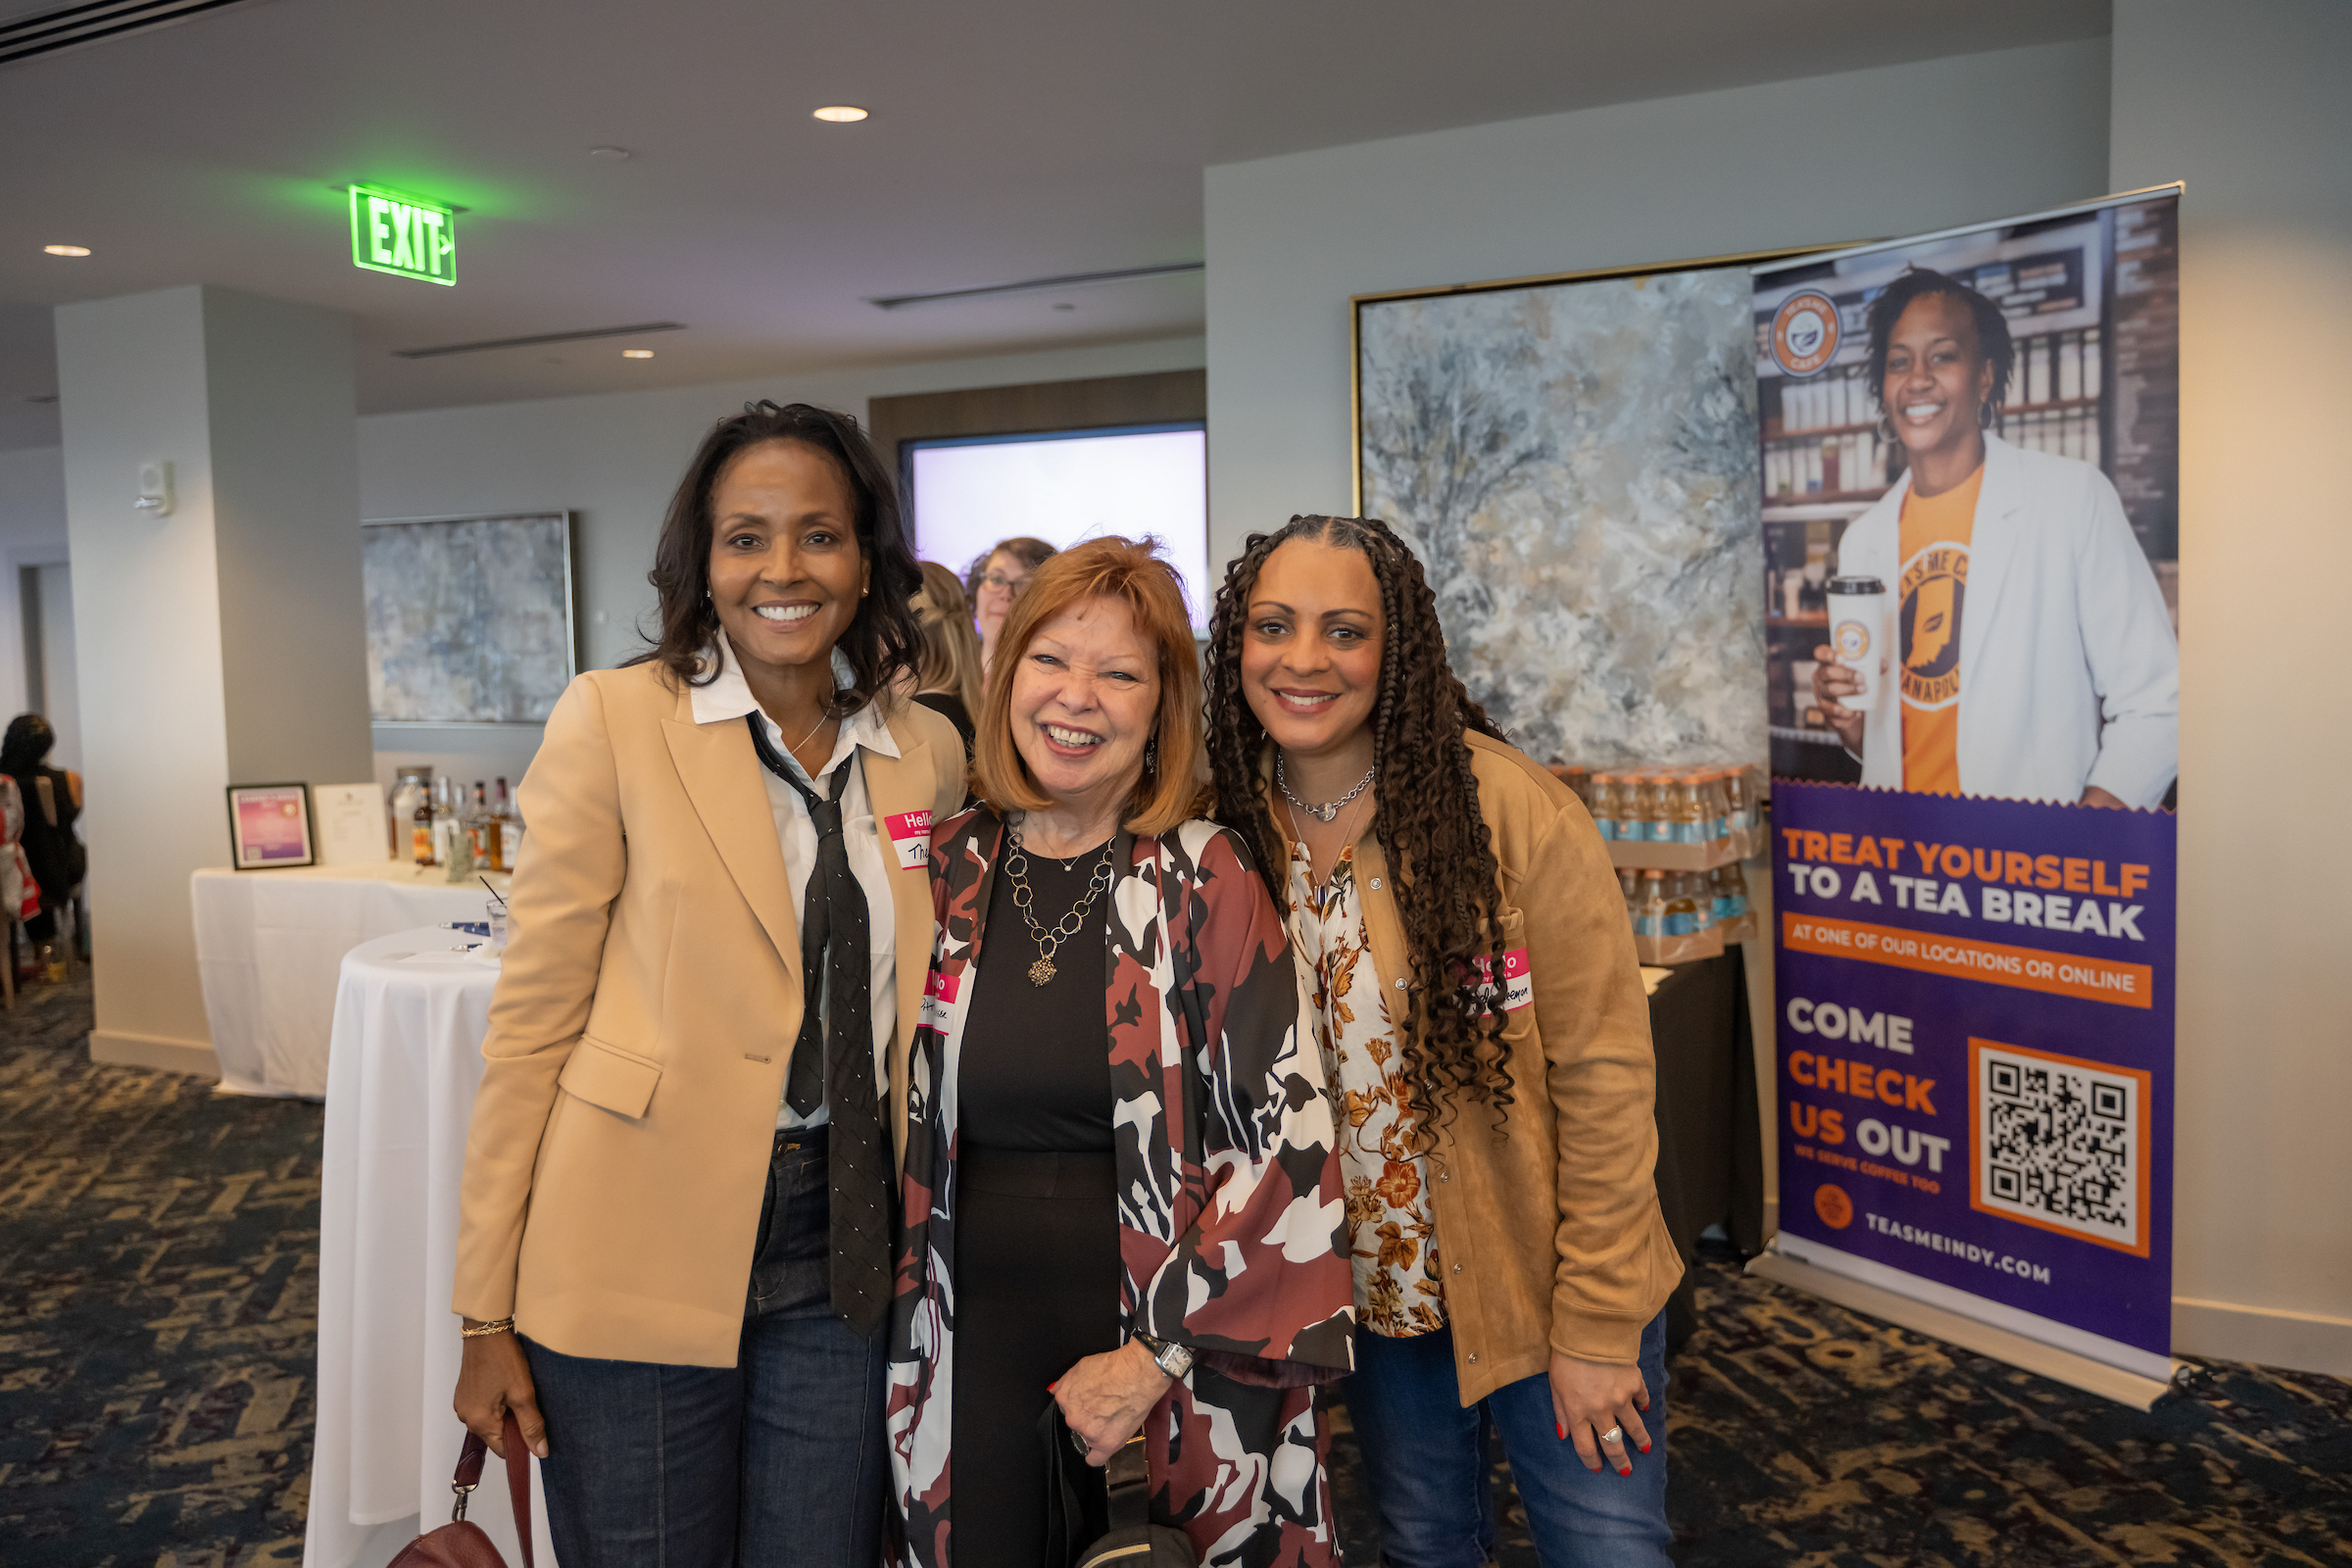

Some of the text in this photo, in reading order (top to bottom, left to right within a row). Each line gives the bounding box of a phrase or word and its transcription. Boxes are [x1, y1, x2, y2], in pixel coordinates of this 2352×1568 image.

[368, 195, 444, 275] EXIT
[1782, 827, 2150, 898] TREAT YOURSELF
[1788, 862, 2145, 942] TO A TEA BREAK
[1792, 923, 2135, 994] AT ONE OF OUR LOCATIONS OR ONLINE
[1787, 997, 1914, 1054] COME
[1788, 1051, 1937, 1116] CHECK
[1790, 1101, 1951, 1173] US OUT
[1794, 1144, 1940, 1195] WE SERVE COFFEE TOO
[1865, 1212, 2050, 1285] TEASMEINDY.COM
